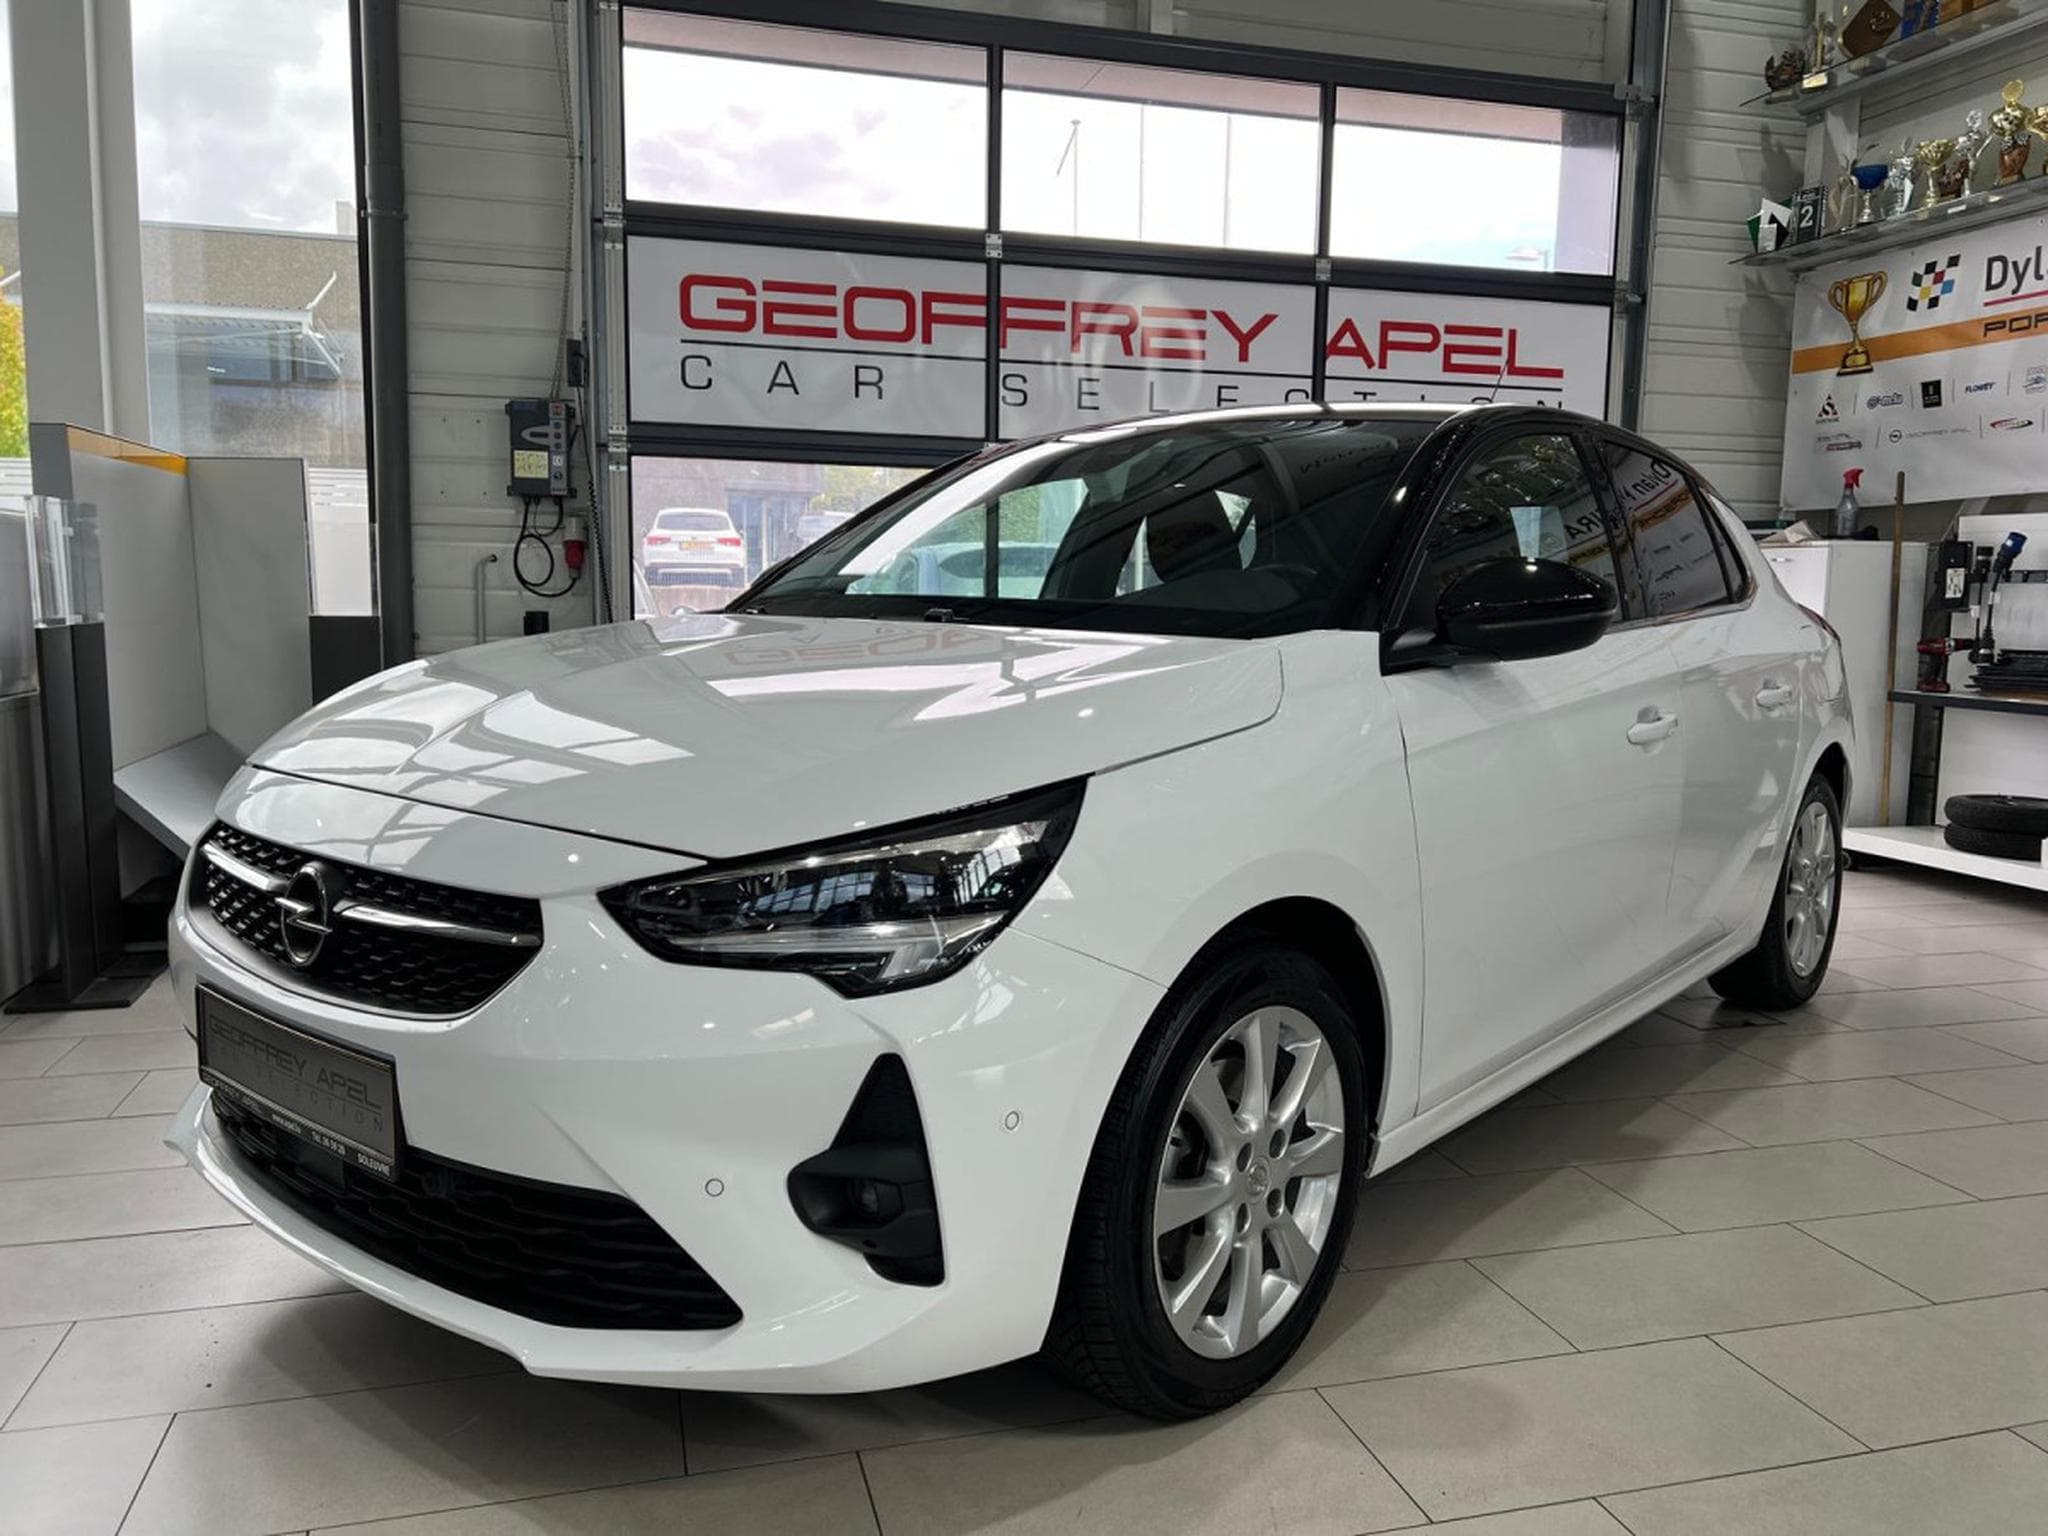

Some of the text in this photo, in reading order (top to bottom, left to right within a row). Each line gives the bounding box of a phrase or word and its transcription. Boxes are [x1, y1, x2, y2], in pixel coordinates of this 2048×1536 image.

[1800, 204, 1813, 228] 2
[1985, 245, 2048, 295] Dyl
[680, 273, 1564, 379] GEOFFREY APEL
[680, 354, 1562, 413] CAR SELEC
[316, 1067, 383, 1110] APEL
